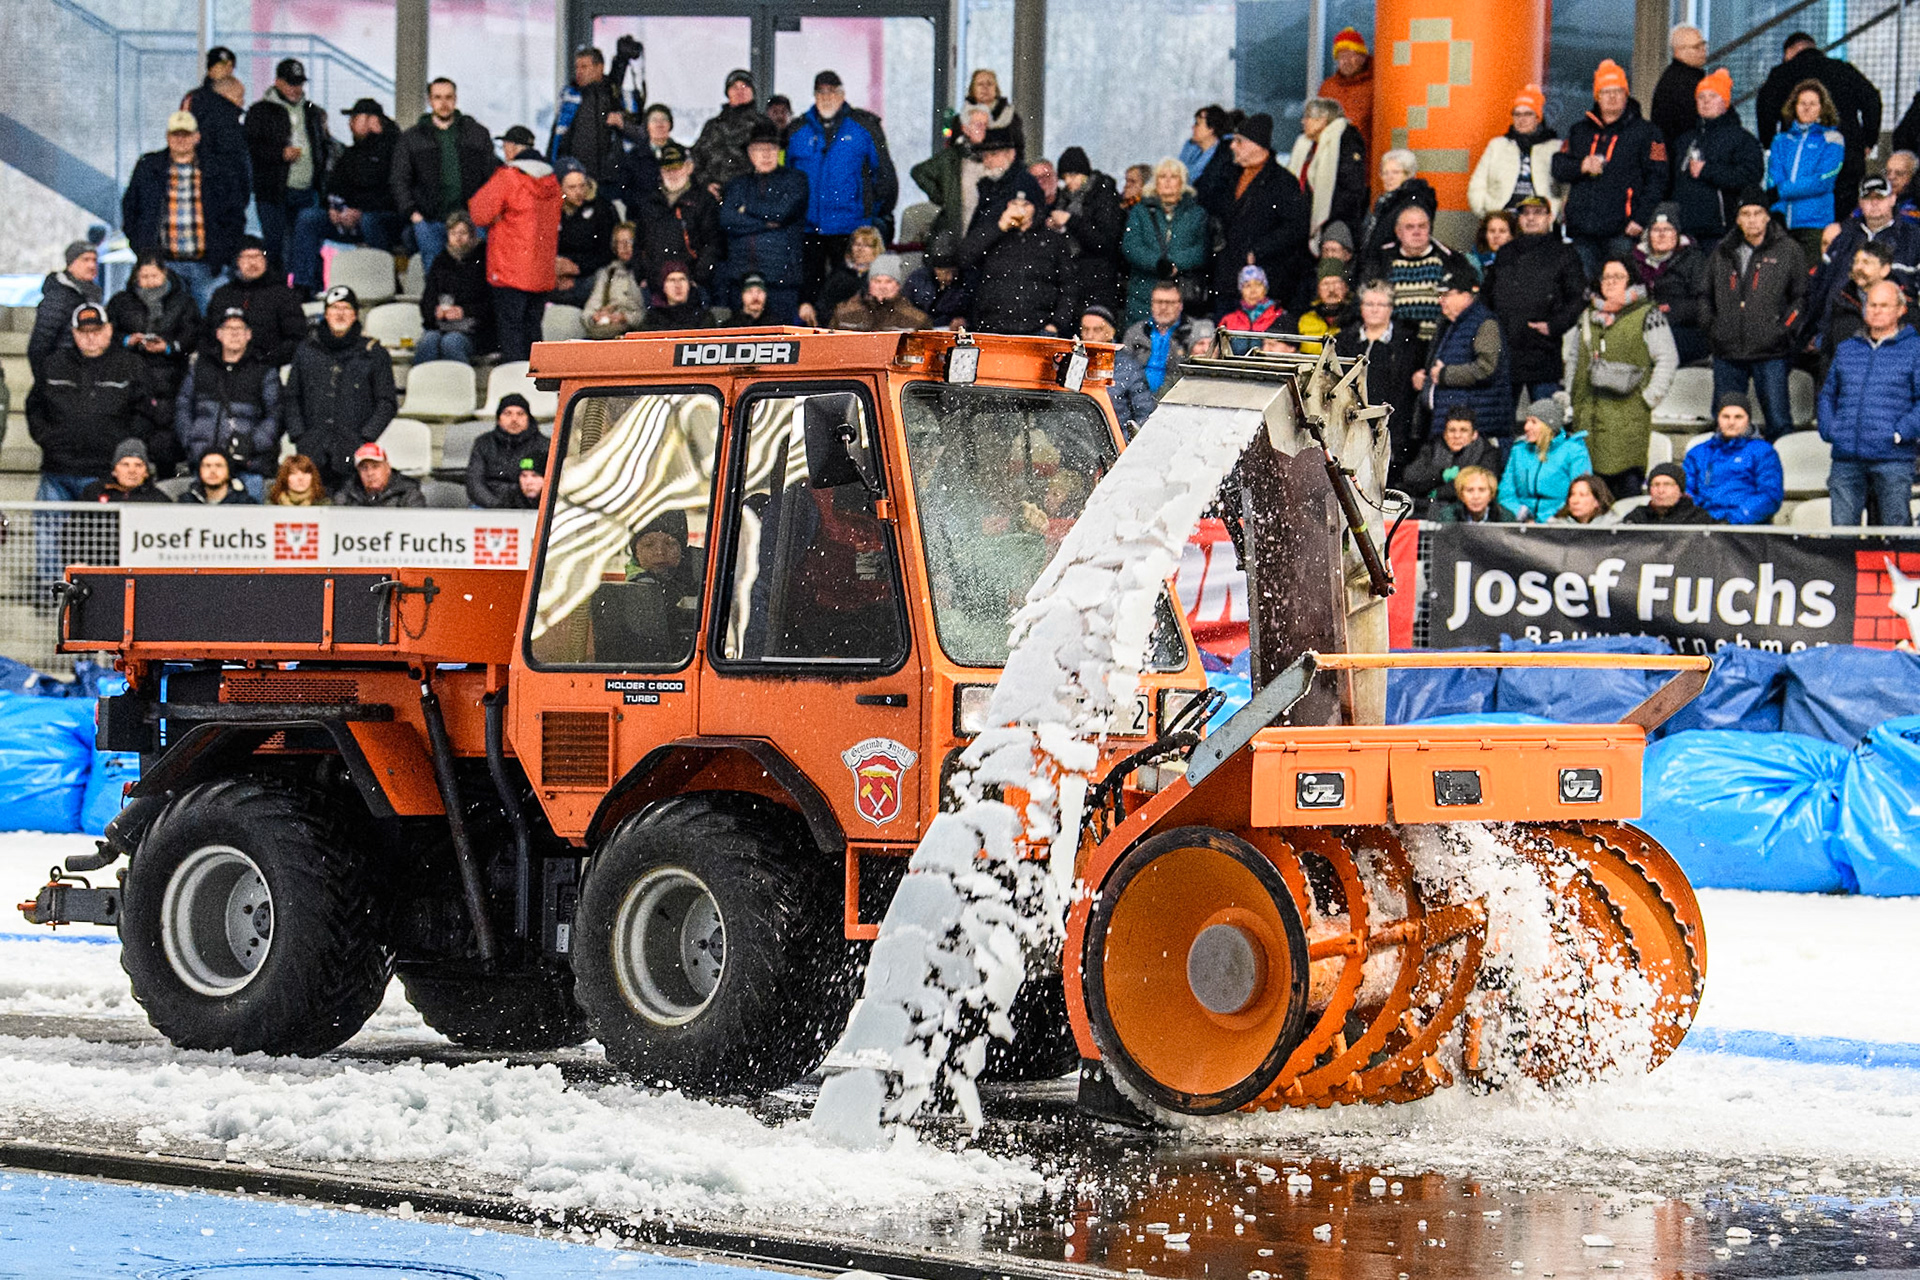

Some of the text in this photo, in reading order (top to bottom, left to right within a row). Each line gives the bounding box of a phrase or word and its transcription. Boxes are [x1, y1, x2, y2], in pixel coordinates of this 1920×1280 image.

[681, 343, 791, 365] HOLDER
[132, 527, 193, 553] Josef
[200, 528, 267, 549] Fuchs
[332, 531, 393, 556] Josef
[400, 532, 466, 553] Fuchs
[1446, 558, 1836, 631] Josef Fuchs
[607, 681, 645, 690] HOLDER
[625, 695, 658, 703] TURBO
[850, 739, 884, 758] Gemeinde
